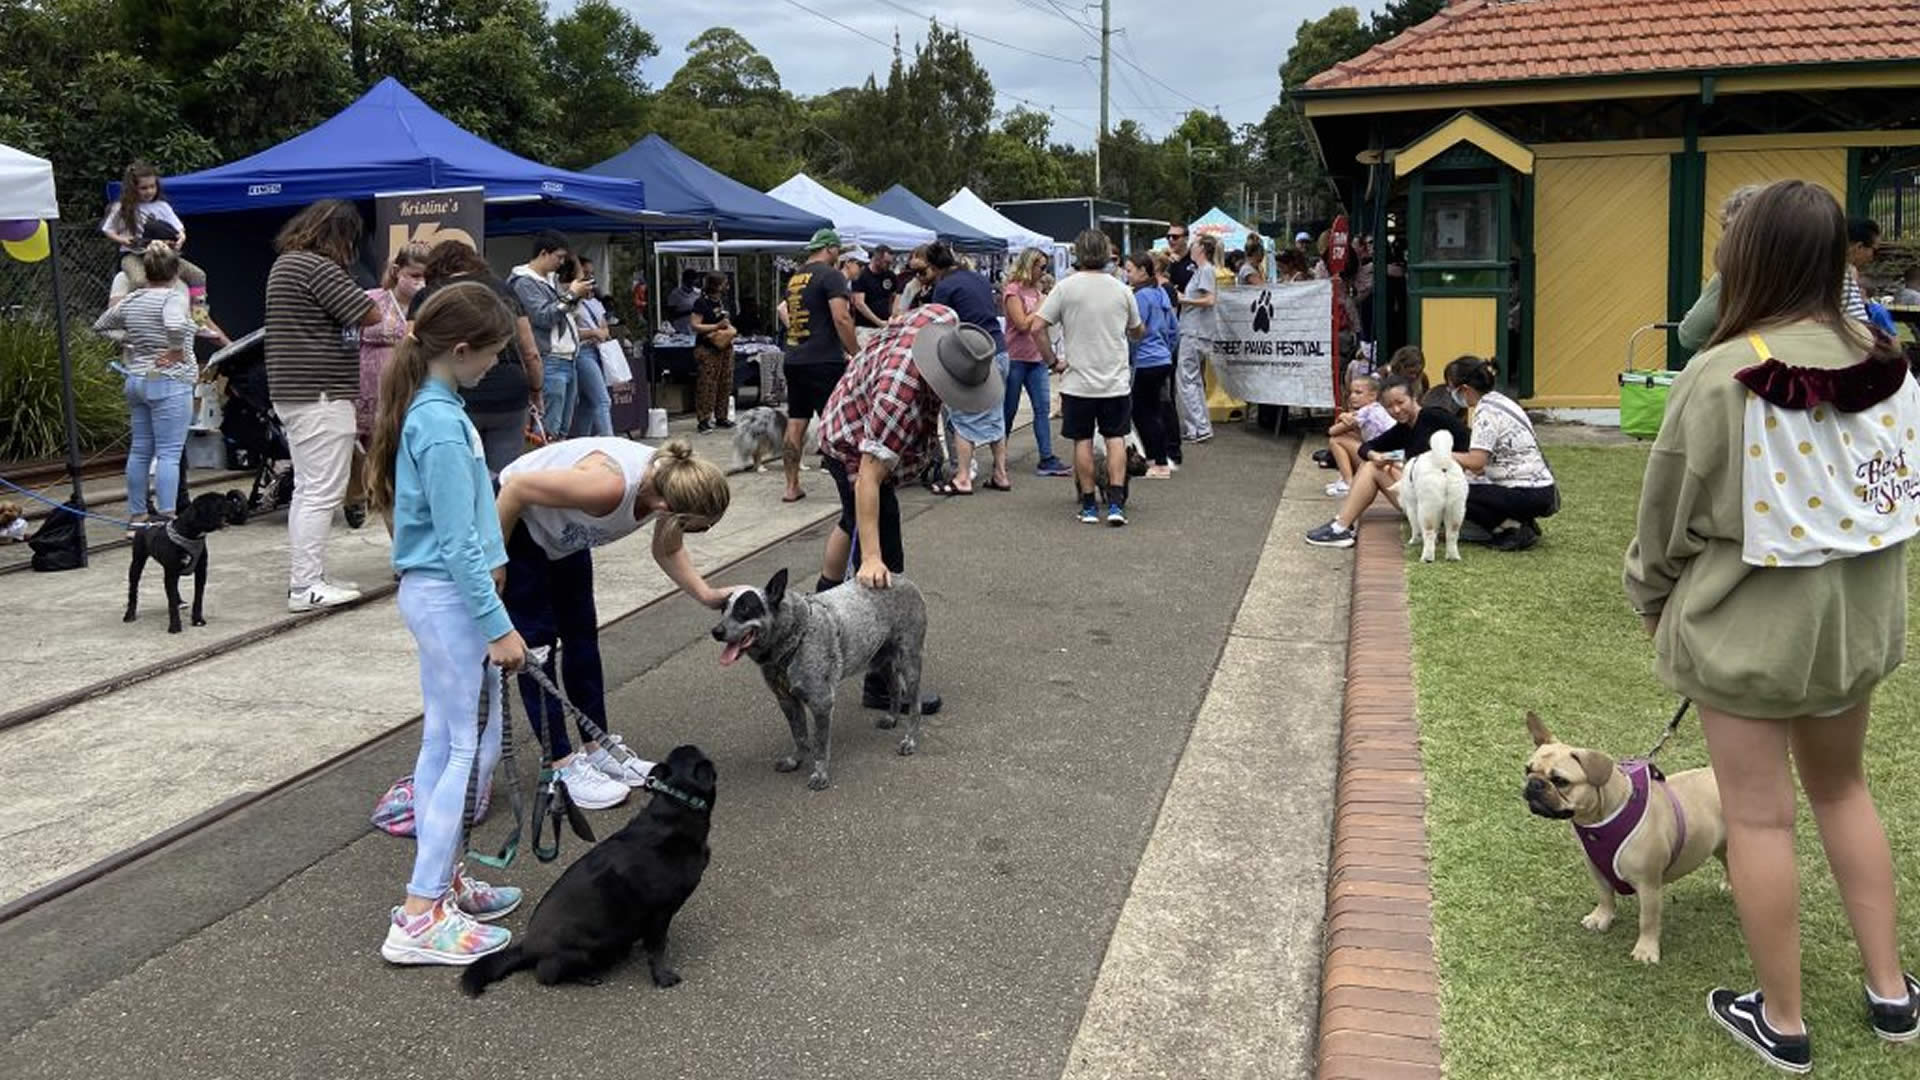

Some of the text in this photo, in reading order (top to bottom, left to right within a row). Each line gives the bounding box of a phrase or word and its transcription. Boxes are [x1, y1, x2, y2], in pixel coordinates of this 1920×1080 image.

[399, 198, 459, 217] Kristine's
[1244, 340, 1273, 356] PAWS
[1276, 340, 1325, 357] FESTIVAL
[1856, 448, 1906, 485] Best
[1862, 484, 1878, 502] in
